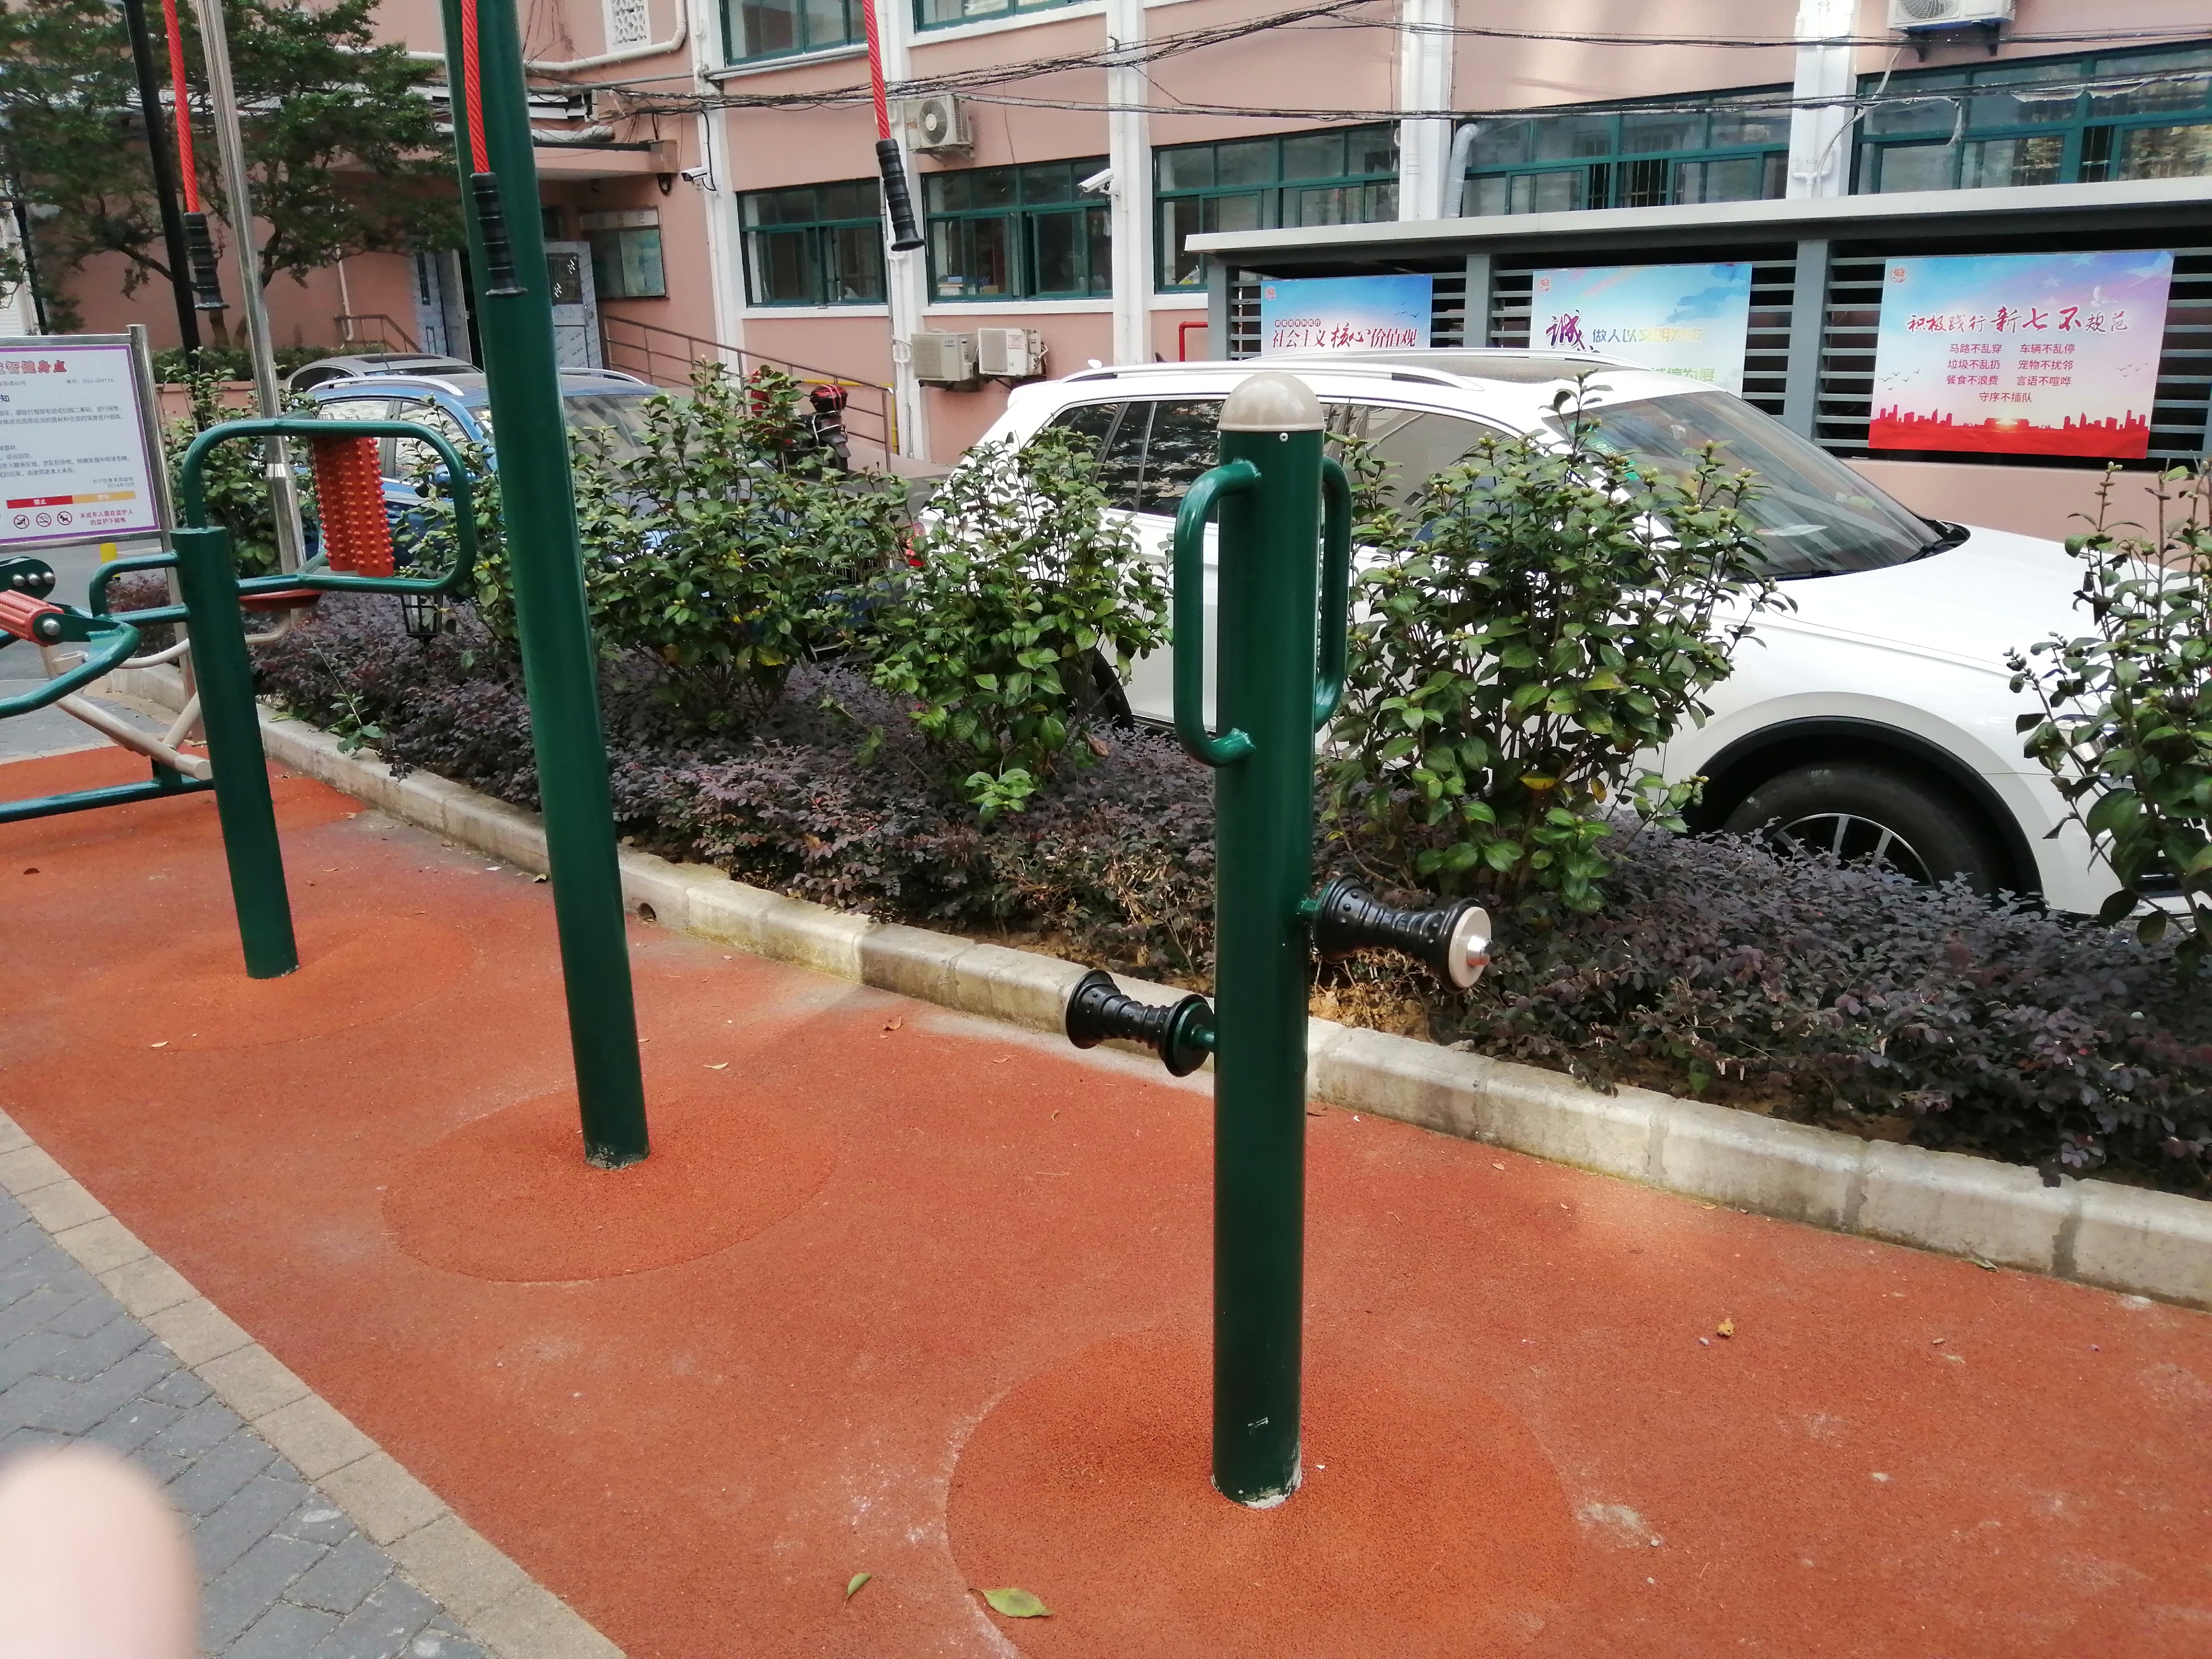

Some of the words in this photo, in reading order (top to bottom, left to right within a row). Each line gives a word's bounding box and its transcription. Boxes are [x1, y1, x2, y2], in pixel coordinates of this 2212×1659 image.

[1907, 306, 2128, 333] 积极践行新七不规范
[1273, 323, 1418, 348] 社会主义核心价值观
[1949, 343, 2002, 354] 马路不乱穿
[2020, 343, 2075, 354] 车辆不乱停
[1948, 360, 2000, 370] 垃圾不乱扔
[2018, 360, 2073, 371] 宠物不扰邻
[1946, 375, 1999, 386] 餐食不浪费
[2016, 376, 2072, 387] 言语不喧哗
[1979, 392, 2032, 403] 守序不插队
